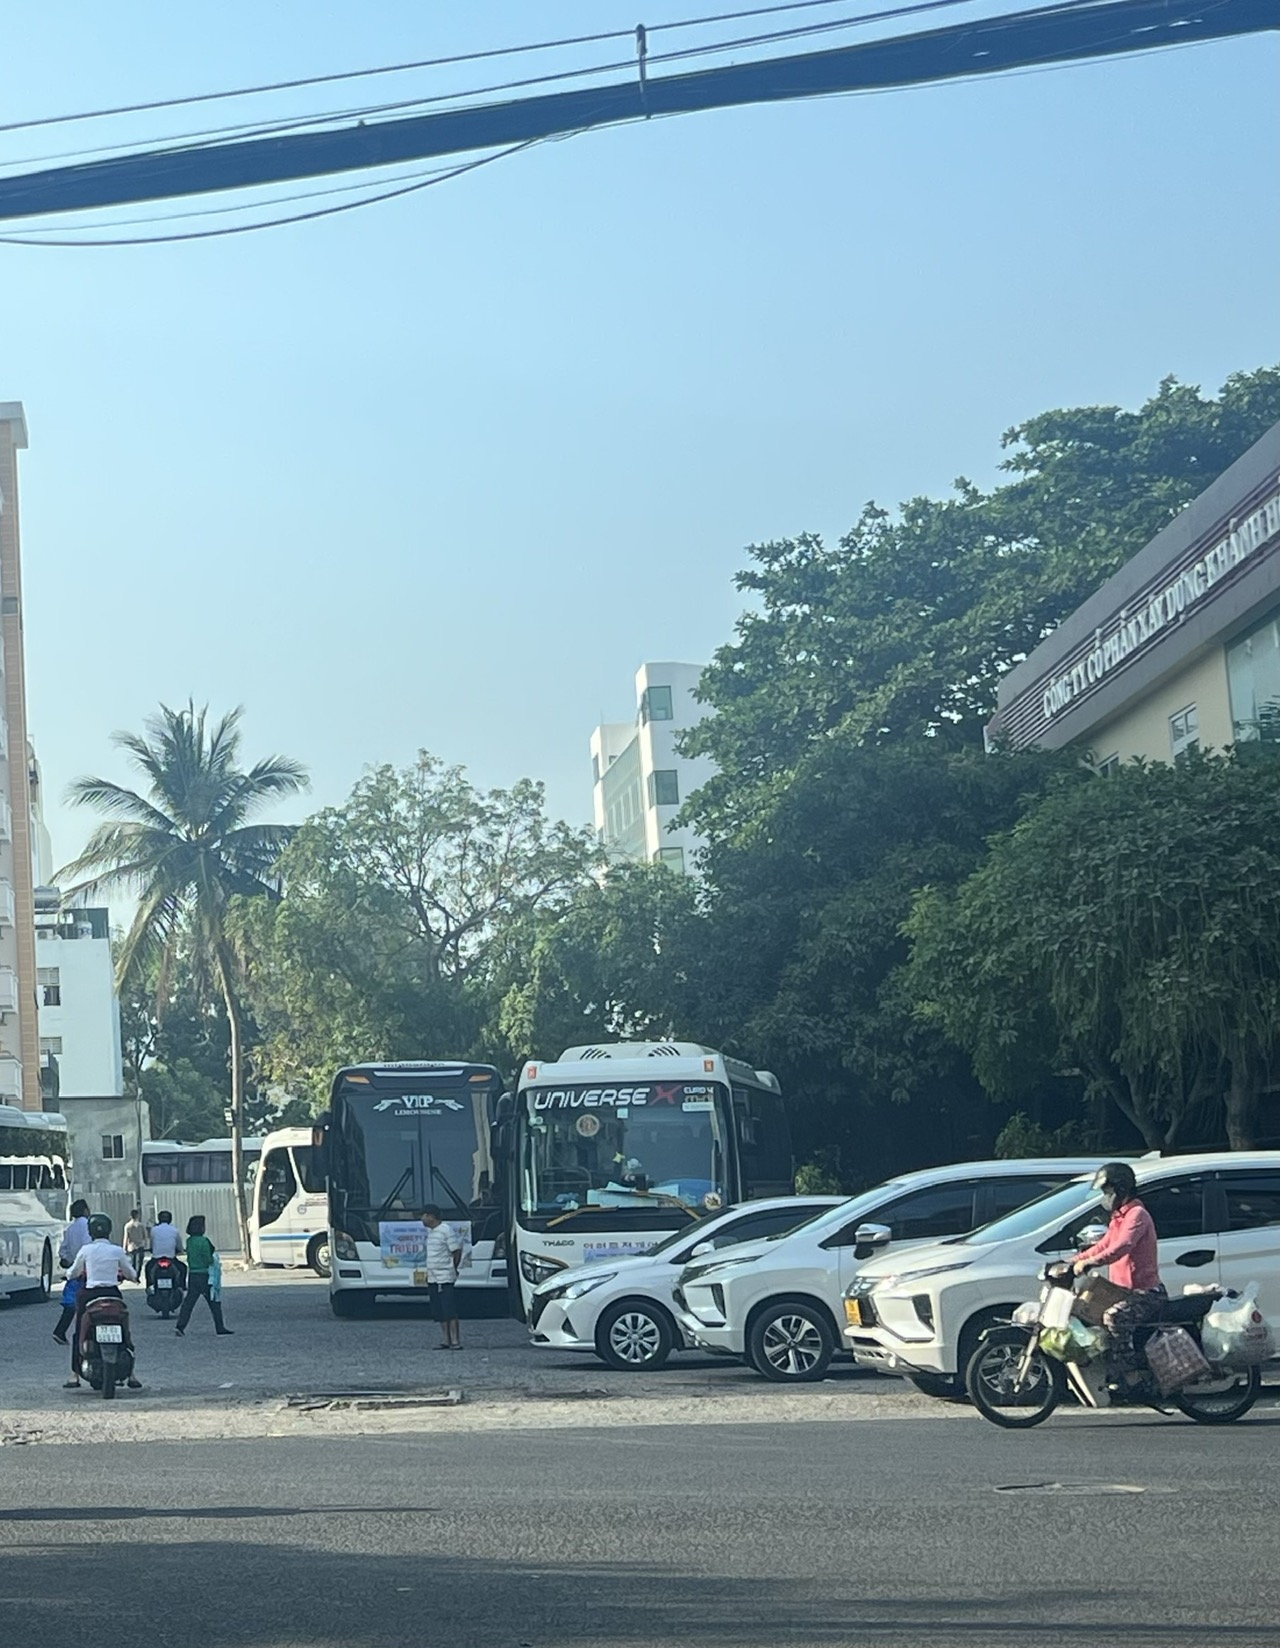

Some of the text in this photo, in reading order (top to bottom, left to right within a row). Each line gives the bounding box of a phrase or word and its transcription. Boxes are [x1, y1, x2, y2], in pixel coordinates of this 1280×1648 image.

[1071, 661, 1089, 695] TY
[401, 1095, 434, 1108] VIP
[534, 1087, 650, 1109] UNIVERSE
[542, 1239, 575, 1247] THACO
